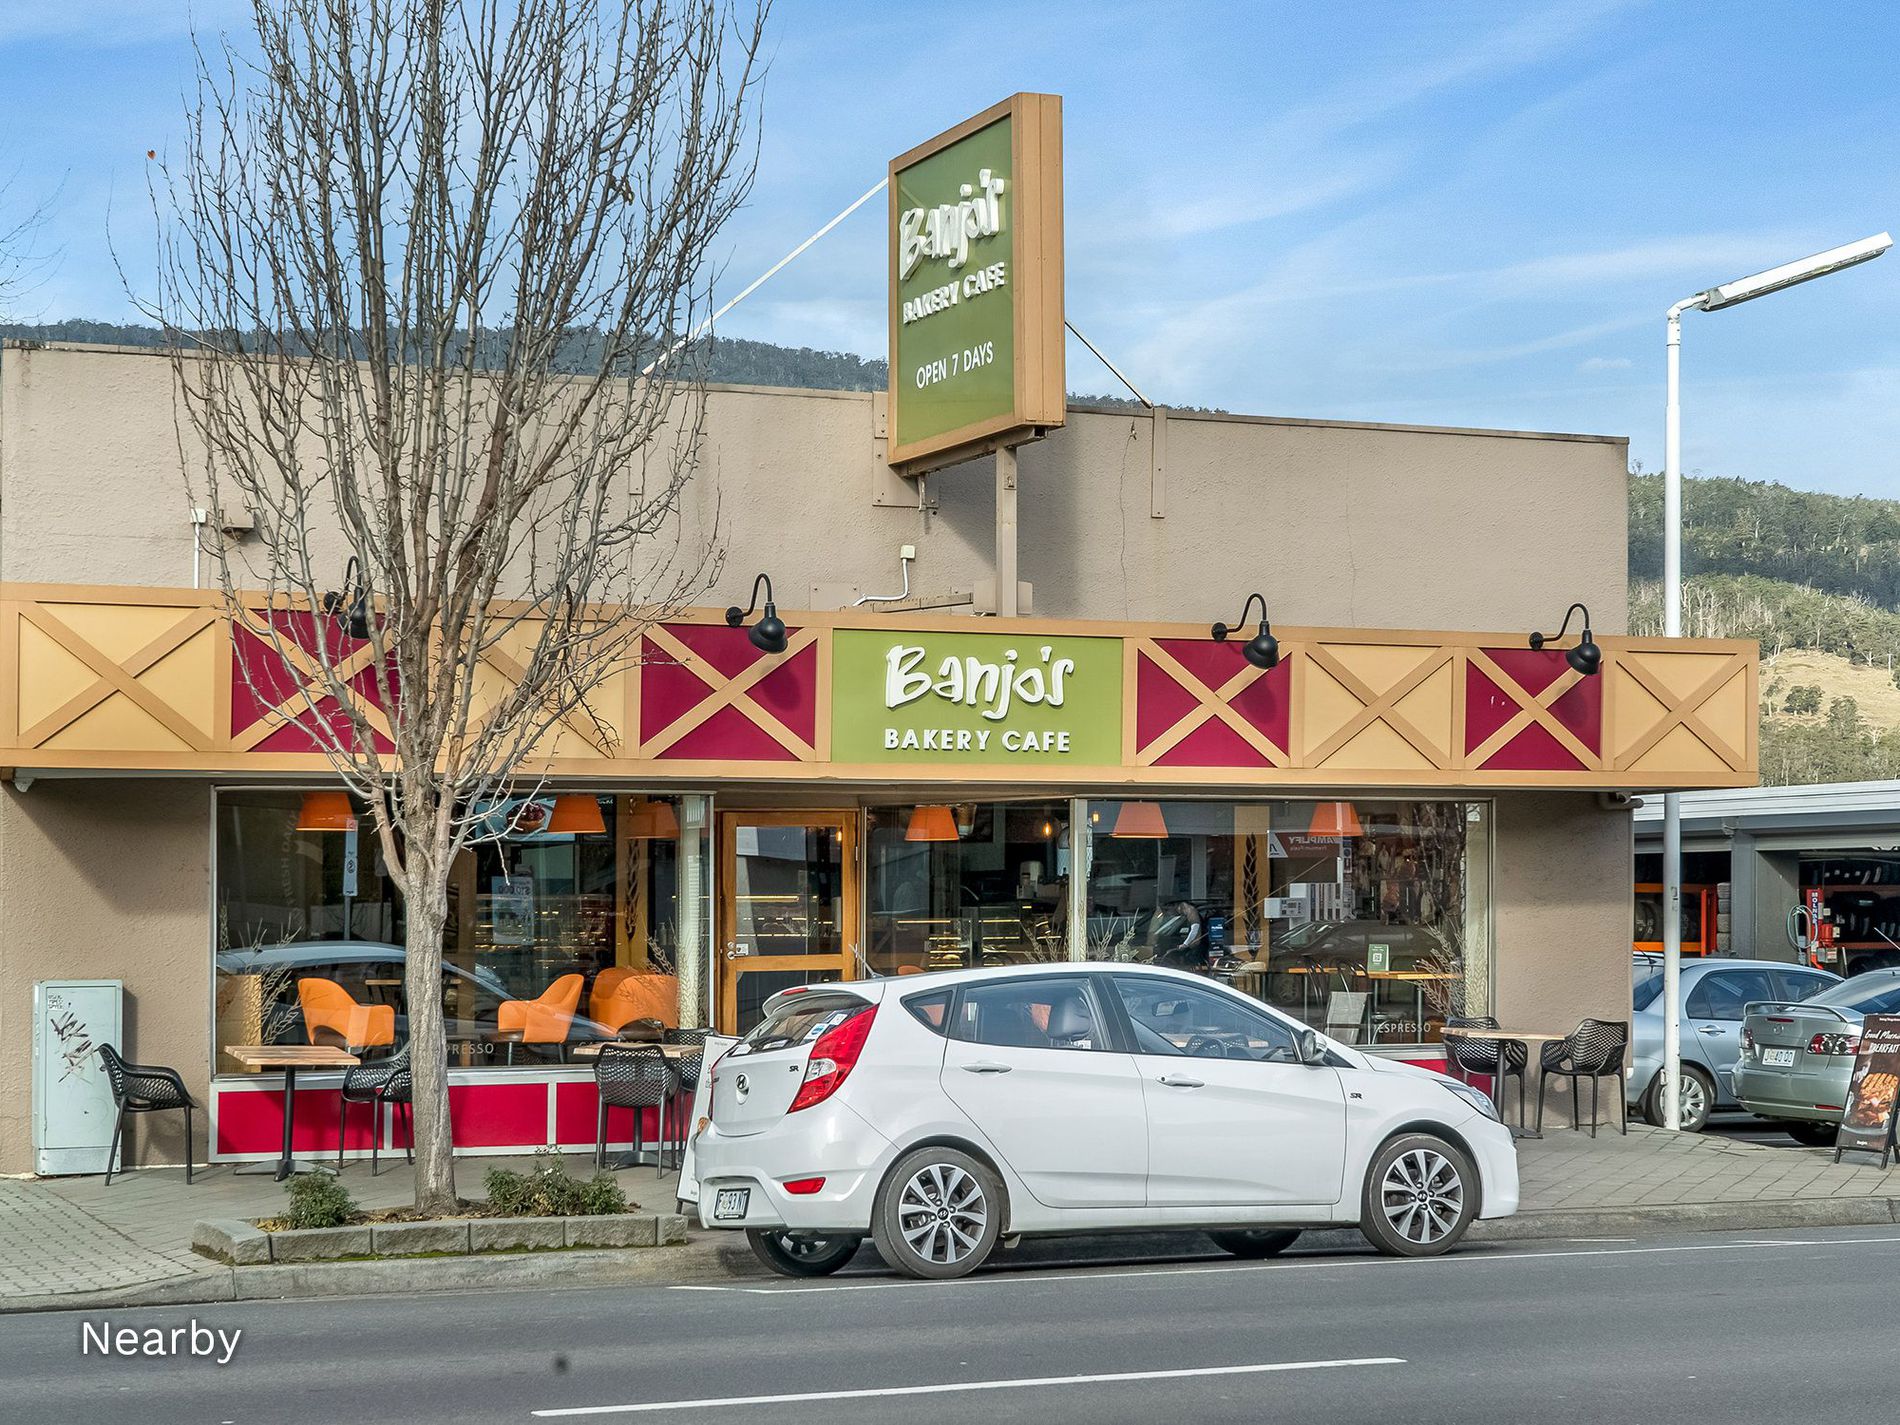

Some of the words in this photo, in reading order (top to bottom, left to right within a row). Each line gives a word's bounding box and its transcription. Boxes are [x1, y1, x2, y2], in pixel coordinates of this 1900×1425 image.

[899, 168, 1005, 281] Banjo's
[902, 280, 960, 325] BAKERY
[962, 261, 1005, 299] CAFE
[915, 357, 947, 390] OPEN
[951, 353, 959, 377] 7
[963, 341, 994, 373] DAYS
[885, 645, 1075, 720] Banjo's
[884, 728, 991, 751] BAKERY
[1002, 730, 1071, 752] CAFE
[446, 1043, 495, 1055] PRESSO
[1378, 1022, 1431, 1033] ESPRESSO
